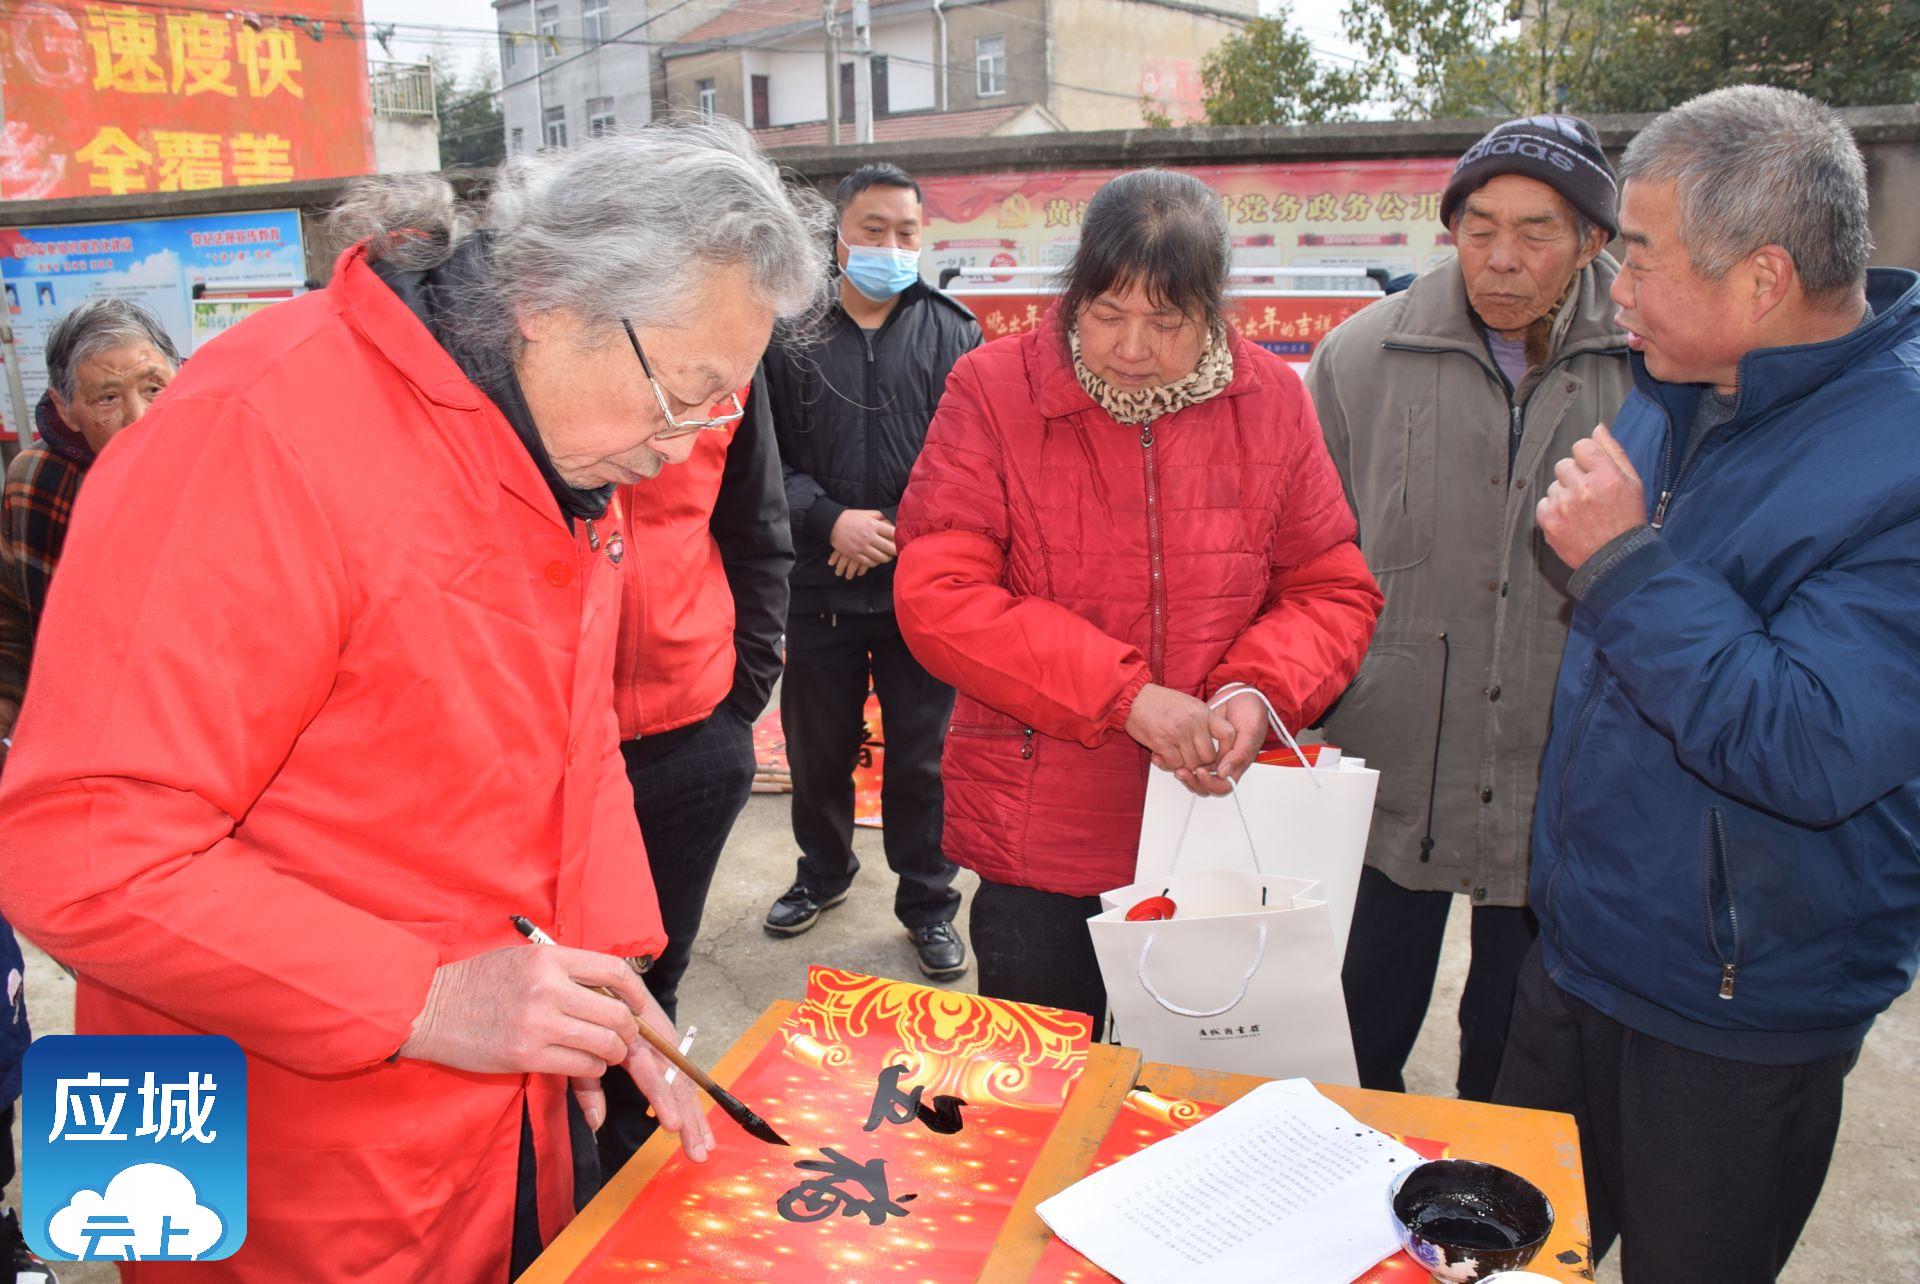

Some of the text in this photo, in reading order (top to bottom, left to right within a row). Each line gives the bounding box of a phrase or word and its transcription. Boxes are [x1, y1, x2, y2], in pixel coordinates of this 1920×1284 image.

[84, 3, 304, 98] 速度快
[75, 126, 295, 196] 全覆盖
